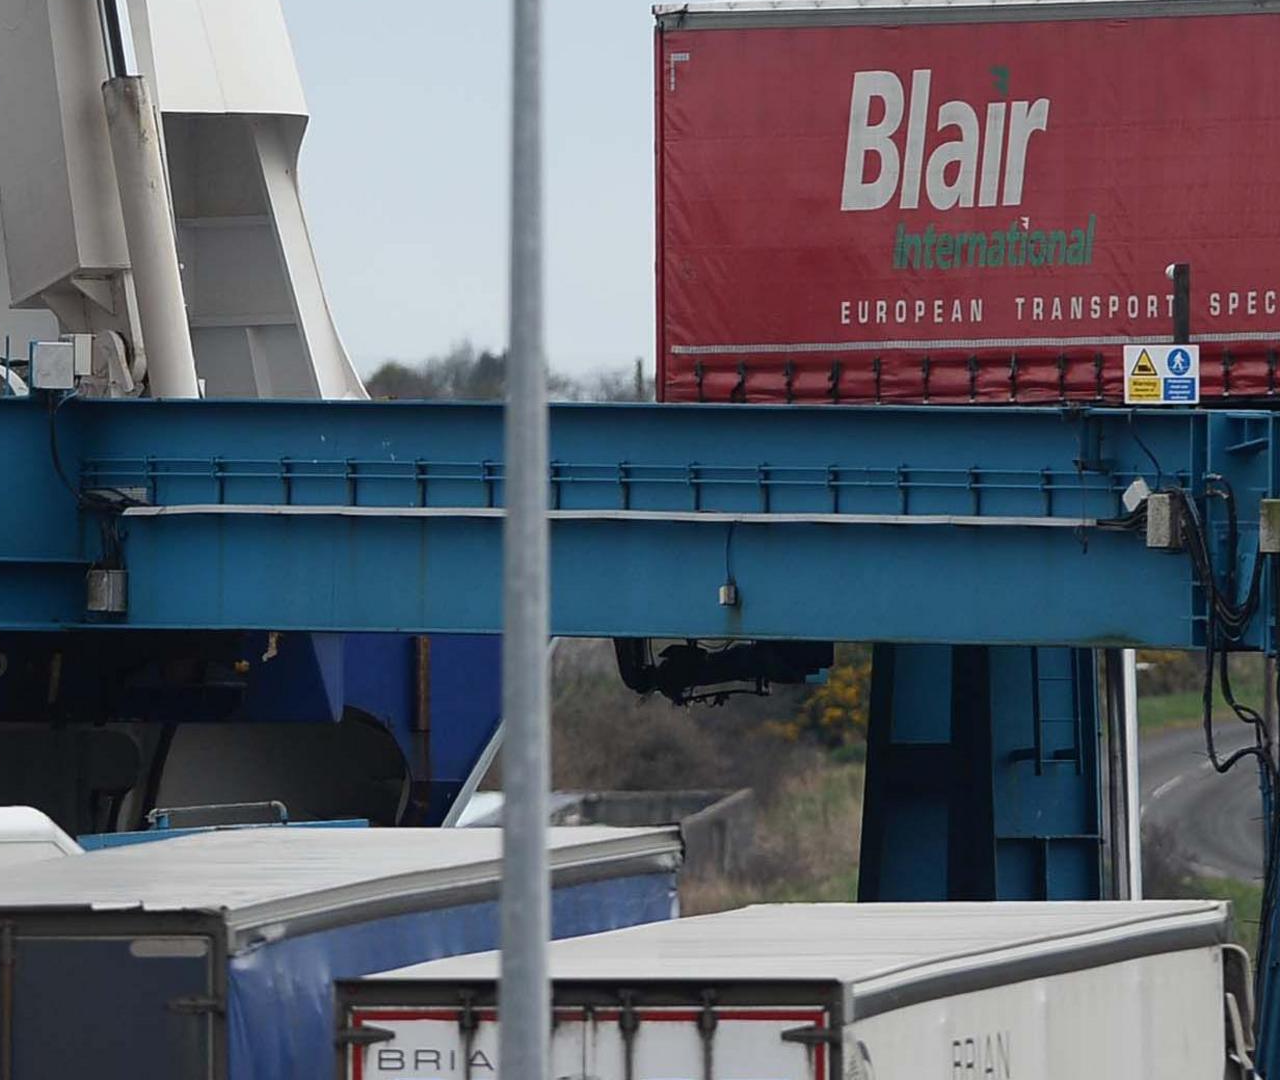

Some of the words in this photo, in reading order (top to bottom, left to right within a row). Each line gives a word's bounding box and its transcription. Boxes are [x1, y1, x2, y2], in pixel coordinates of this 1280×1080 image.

[840, 65, 1051, 212] Blair
[892, 212, 1098, 271] International
[840, 298, 983, 324] EUROPEAN
[377, 1049, 494, 1071] BRIA
